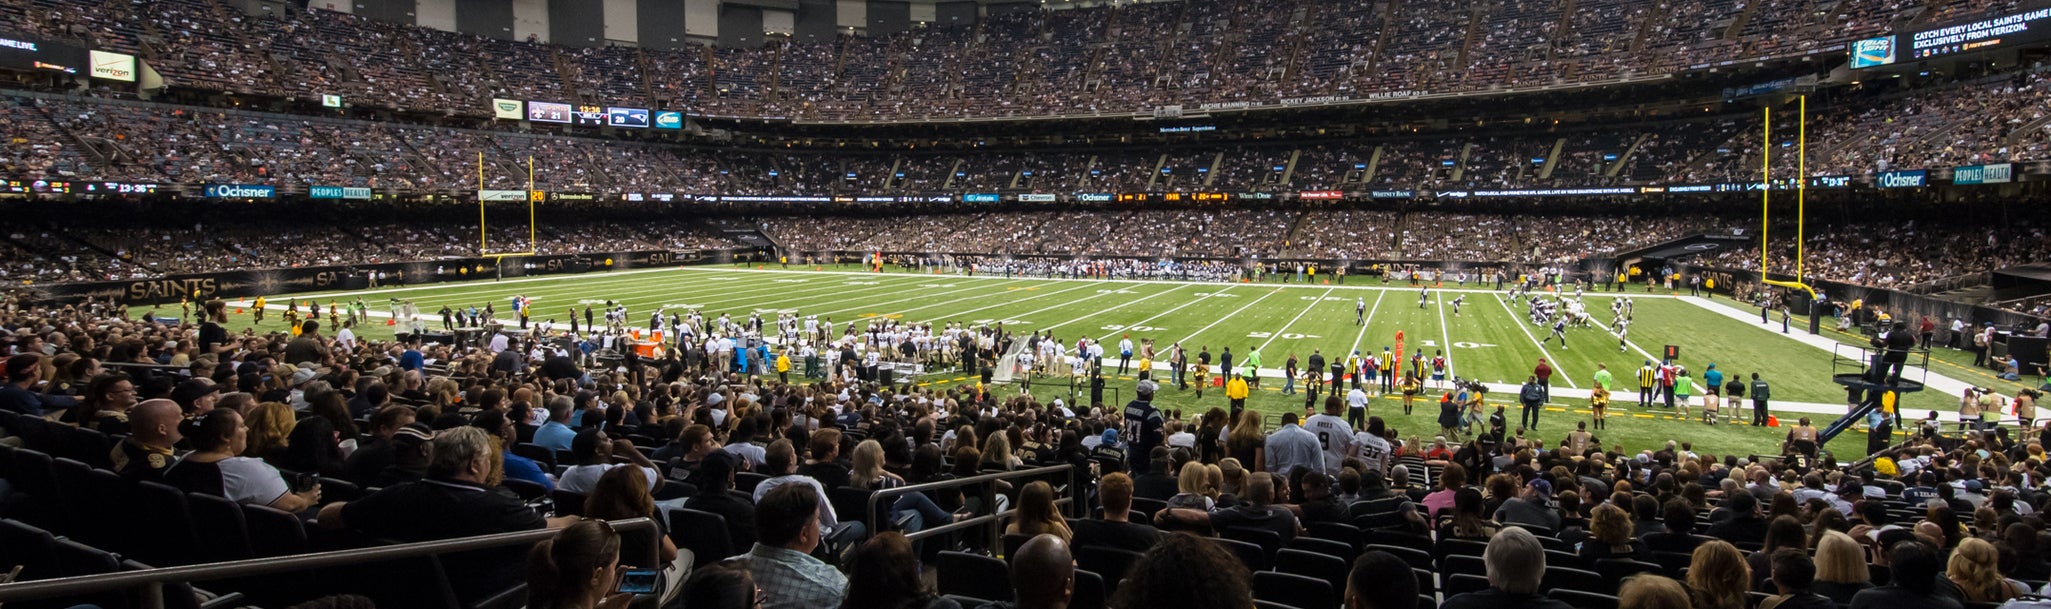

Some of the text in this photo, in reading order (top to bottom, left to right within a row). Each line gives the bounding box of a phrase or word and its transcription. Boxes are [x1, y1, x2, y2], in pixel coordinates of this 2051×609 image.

[1914, 30, 1939, 40] CATCH
[1940, 25, 1967, 37] EVERY
[1968, 20, 1992, 31] LOCAL
[1993, 14, 2023, 27] SAINTS
[2024, 9, 2048, 21] GAME
[1914, 22, 2028, 49] EXCLUSIVELY FROM VERIZON.
[95, 66, 129, 76] verizon
[550, 112, 561, 120] 21
[1885, 172, 1921, 187] Ochsner
[1955, 166, 2010, 182] PEOPLES HEALTH
[119, 184, 147, 192] 13:36
[218, 185, 270, 198] Ochsner
[312, 188, 342, 197] PEOPLES
[500, 193, 524, 201] verizon
[1082, 193, 1110, 201] Ochsner
[131, 278, 216, 300] SAINTS
[1125, 418, 1142, 443] 87
[1319, 431, 1330, 450] 9
[1363, 444, 1380, 459] 37
